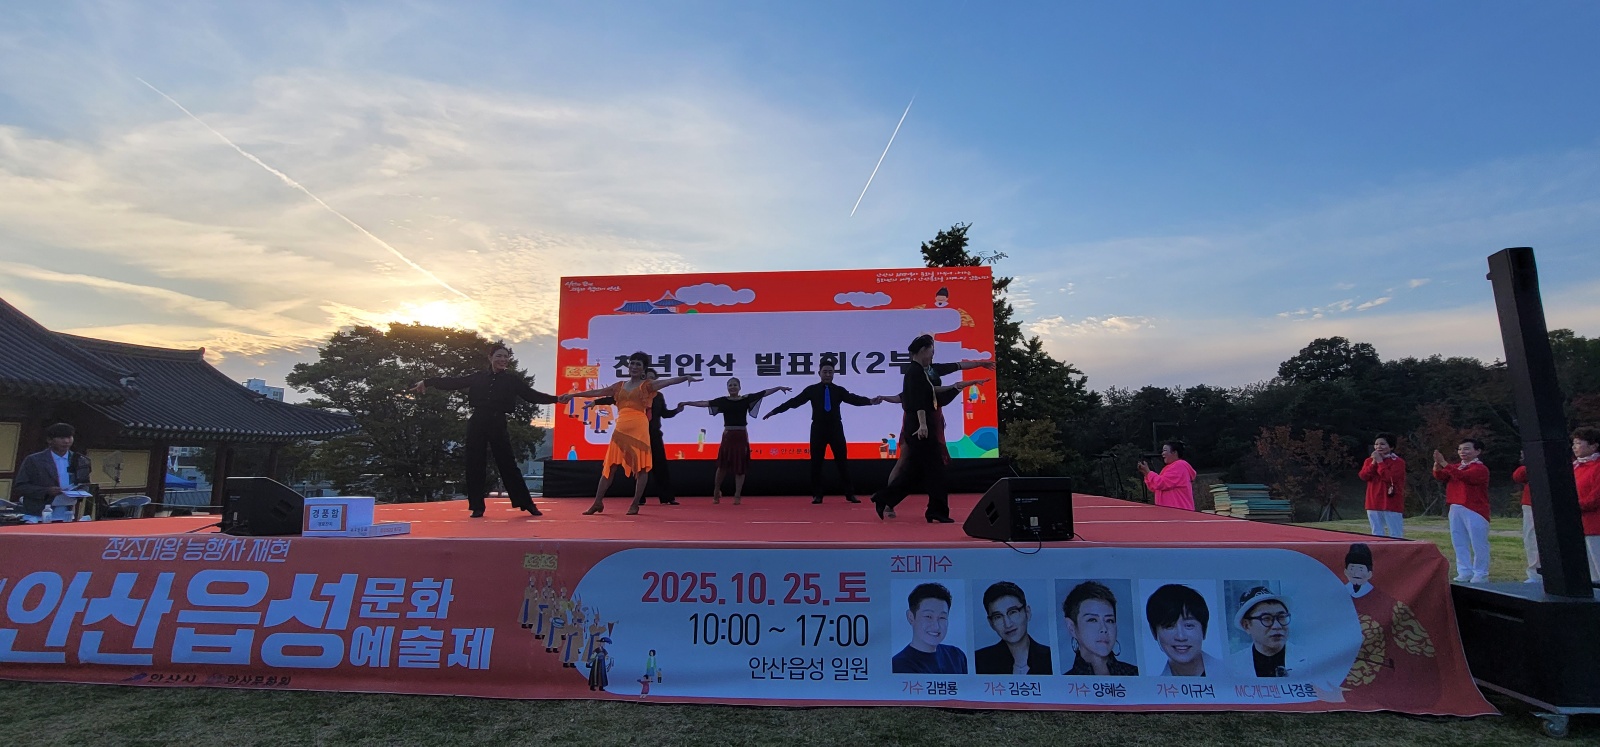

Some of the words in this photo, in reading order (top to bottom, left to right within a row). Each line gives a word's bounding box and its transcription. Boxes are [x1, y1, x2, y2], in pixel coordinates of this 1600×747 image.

[755, 350, 914, 377] 발표회(2부
[102, 537, 182, 561] 정조대왕
[183, 537, 247, 562] 능행차
[246, 539, 292, 563] 재현
[890, 554, 953, 574] 초대가수
[360, 577, 455, 620] 문화
[0, 569, 359, 669] 안산읍성
[689, 612, 761, 646] 10:00
[796, 614, 869, 647] 17:00
[350, 625, 495, 671] 예술제
[148, 673, 197, 684] 안산시
[749, 656, 825, 681] 안산읍성
[831, 657, 869, 681] 일원
[902, 681, 924, 695] 가수
[926, 681, 959, 696] 김범룡
[984, 681, 1006, 696] 가수
[1008, 682, 1042, 697] 김승진
[1068, 682, 1091, 698] 가수
[1092, 682, 1127, 698] 양혜승
[1157, 683, 1179, 698] 가수
[1181, 684, 1216, 699] 이규석
[1280, 684, 1318, 699] 나경훈
